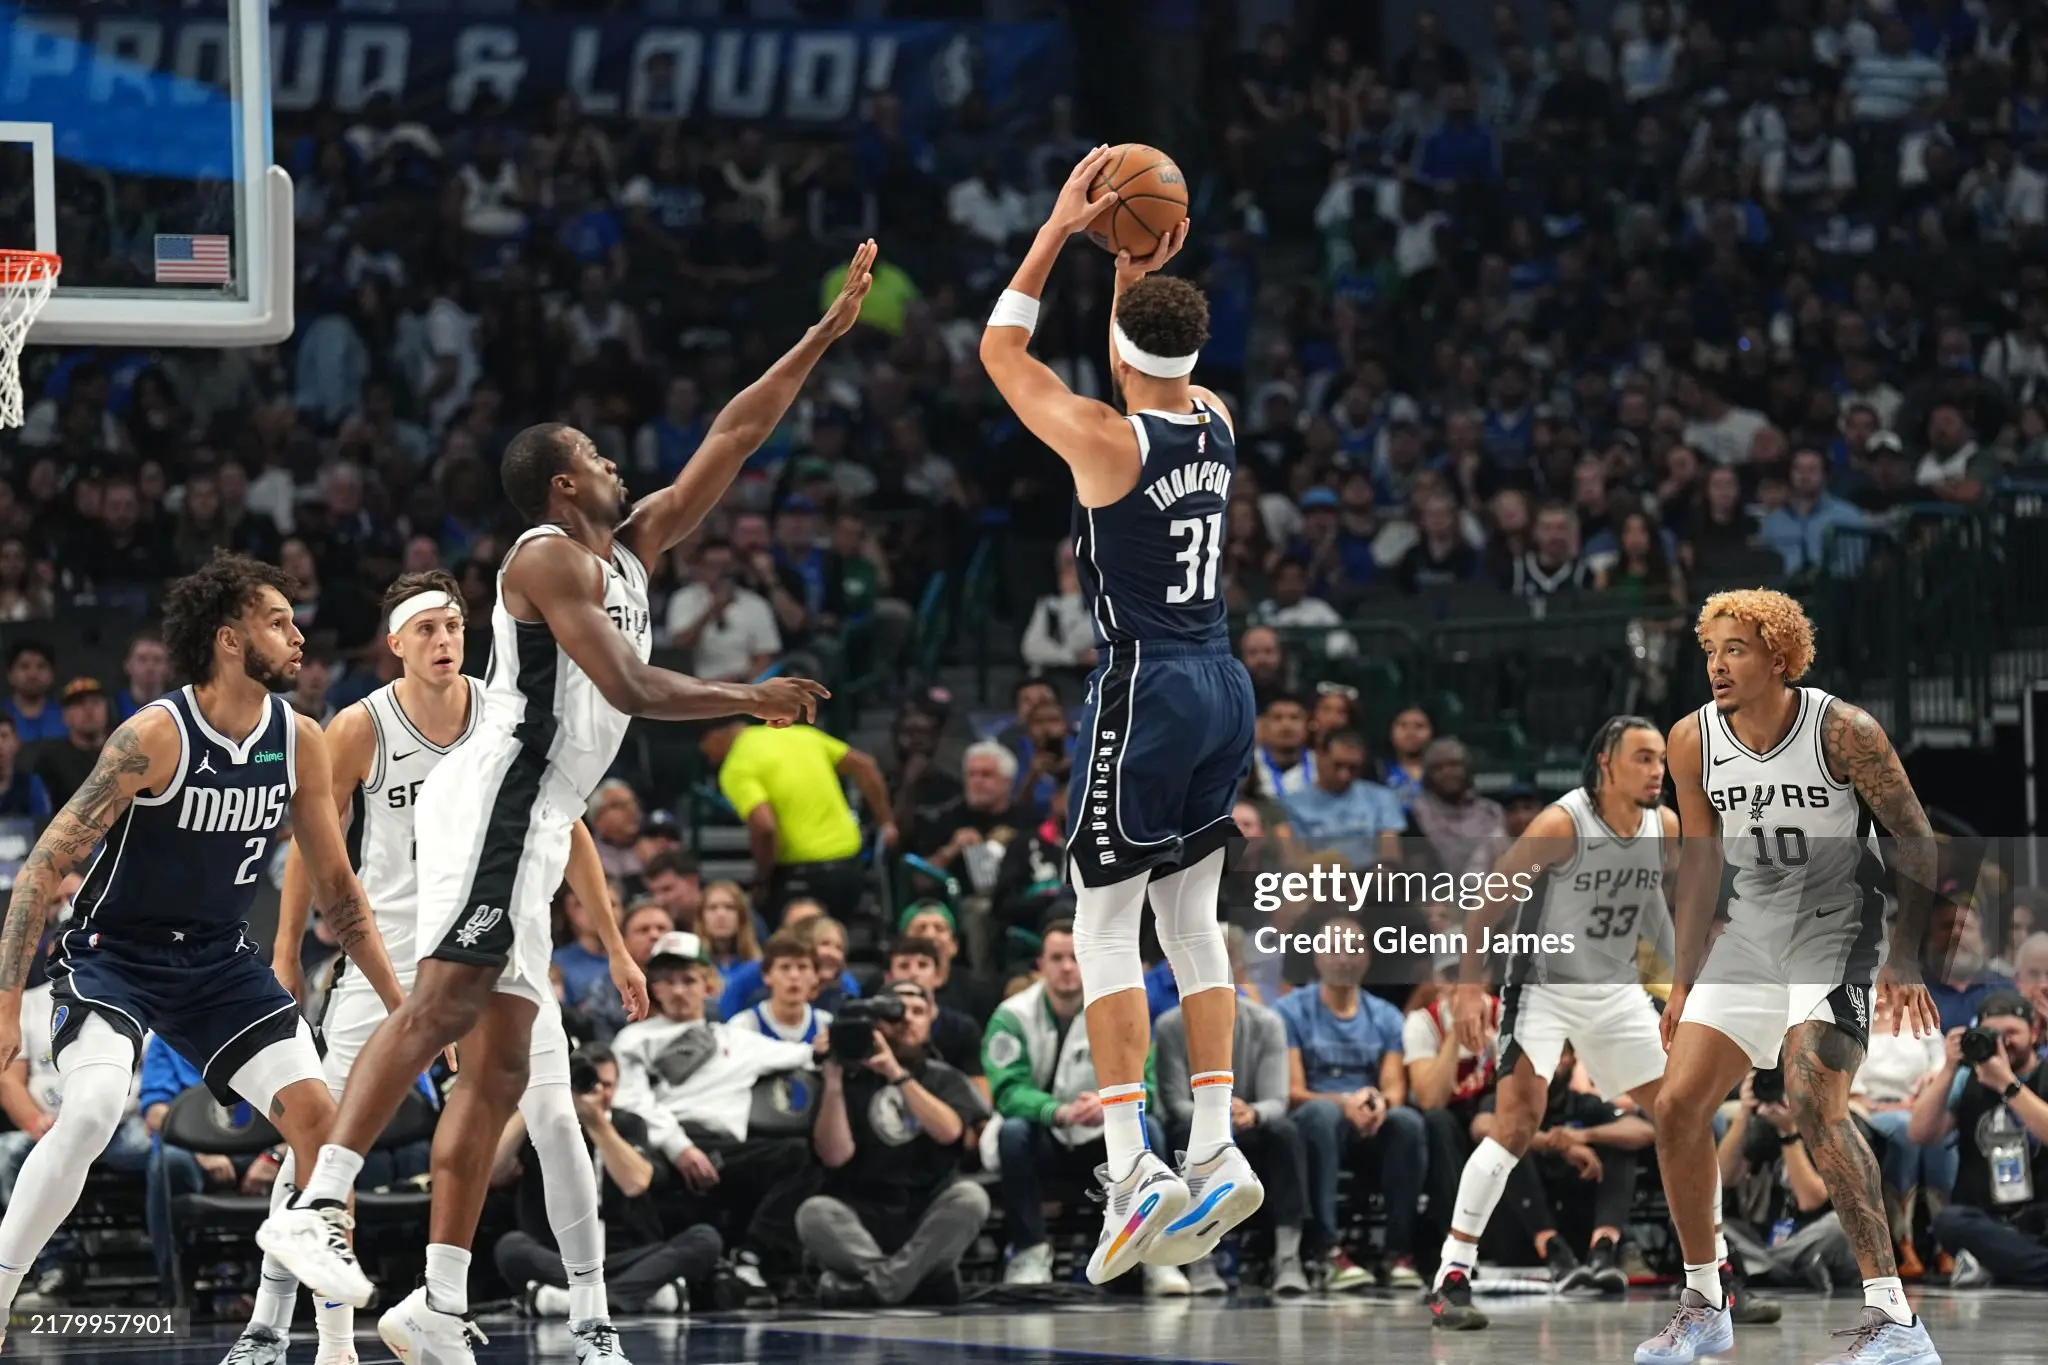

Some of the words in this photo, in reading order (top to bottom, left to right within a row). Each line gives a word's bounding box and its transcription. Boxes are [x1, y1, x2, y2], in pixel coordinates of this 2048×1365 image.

[5, 13, 411, 113] PROUD
[1143, 460, 1232, 512] THOMPSON
[1165, 512, 1223, 604] 31
[254, 750, 285, 764] chime
[1710, 783, 1830, 823] SPURS
[233, 836, 267, 886] 2
[1748, 825, 1811, 869] 10
[1573, 867, 1660, 899] SPURS
[1585, 904, 1640, 941] 33
